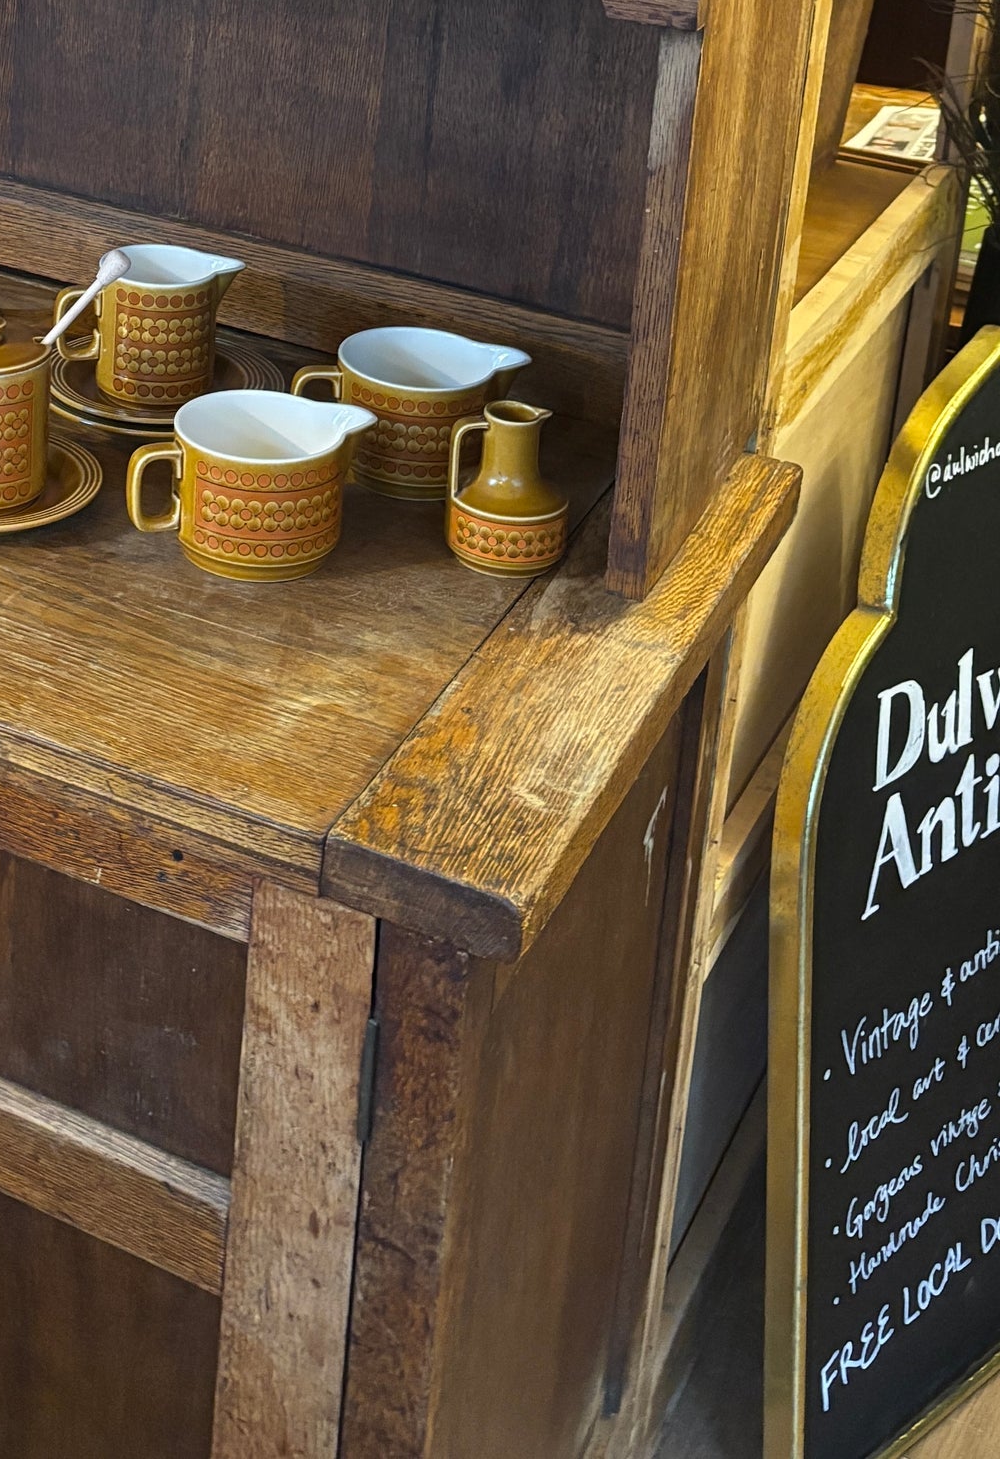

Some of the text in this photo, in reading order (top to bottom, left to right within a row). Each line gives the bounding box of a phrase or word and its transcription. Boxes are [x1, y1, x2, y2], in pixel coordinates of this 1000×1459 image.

[860, 753, 1000, 921] Anti
[841, 992, 934, 1075] Vintage
[912, 1057, 946, 1101] art
[846, 1155, 924, 1239] Gorgeous
[848, 1137, 1000, 1295] Handmade Chri
[821, 1303, 895, 1412] FREE
[903, 1242, 972, 1325] LOCAL
